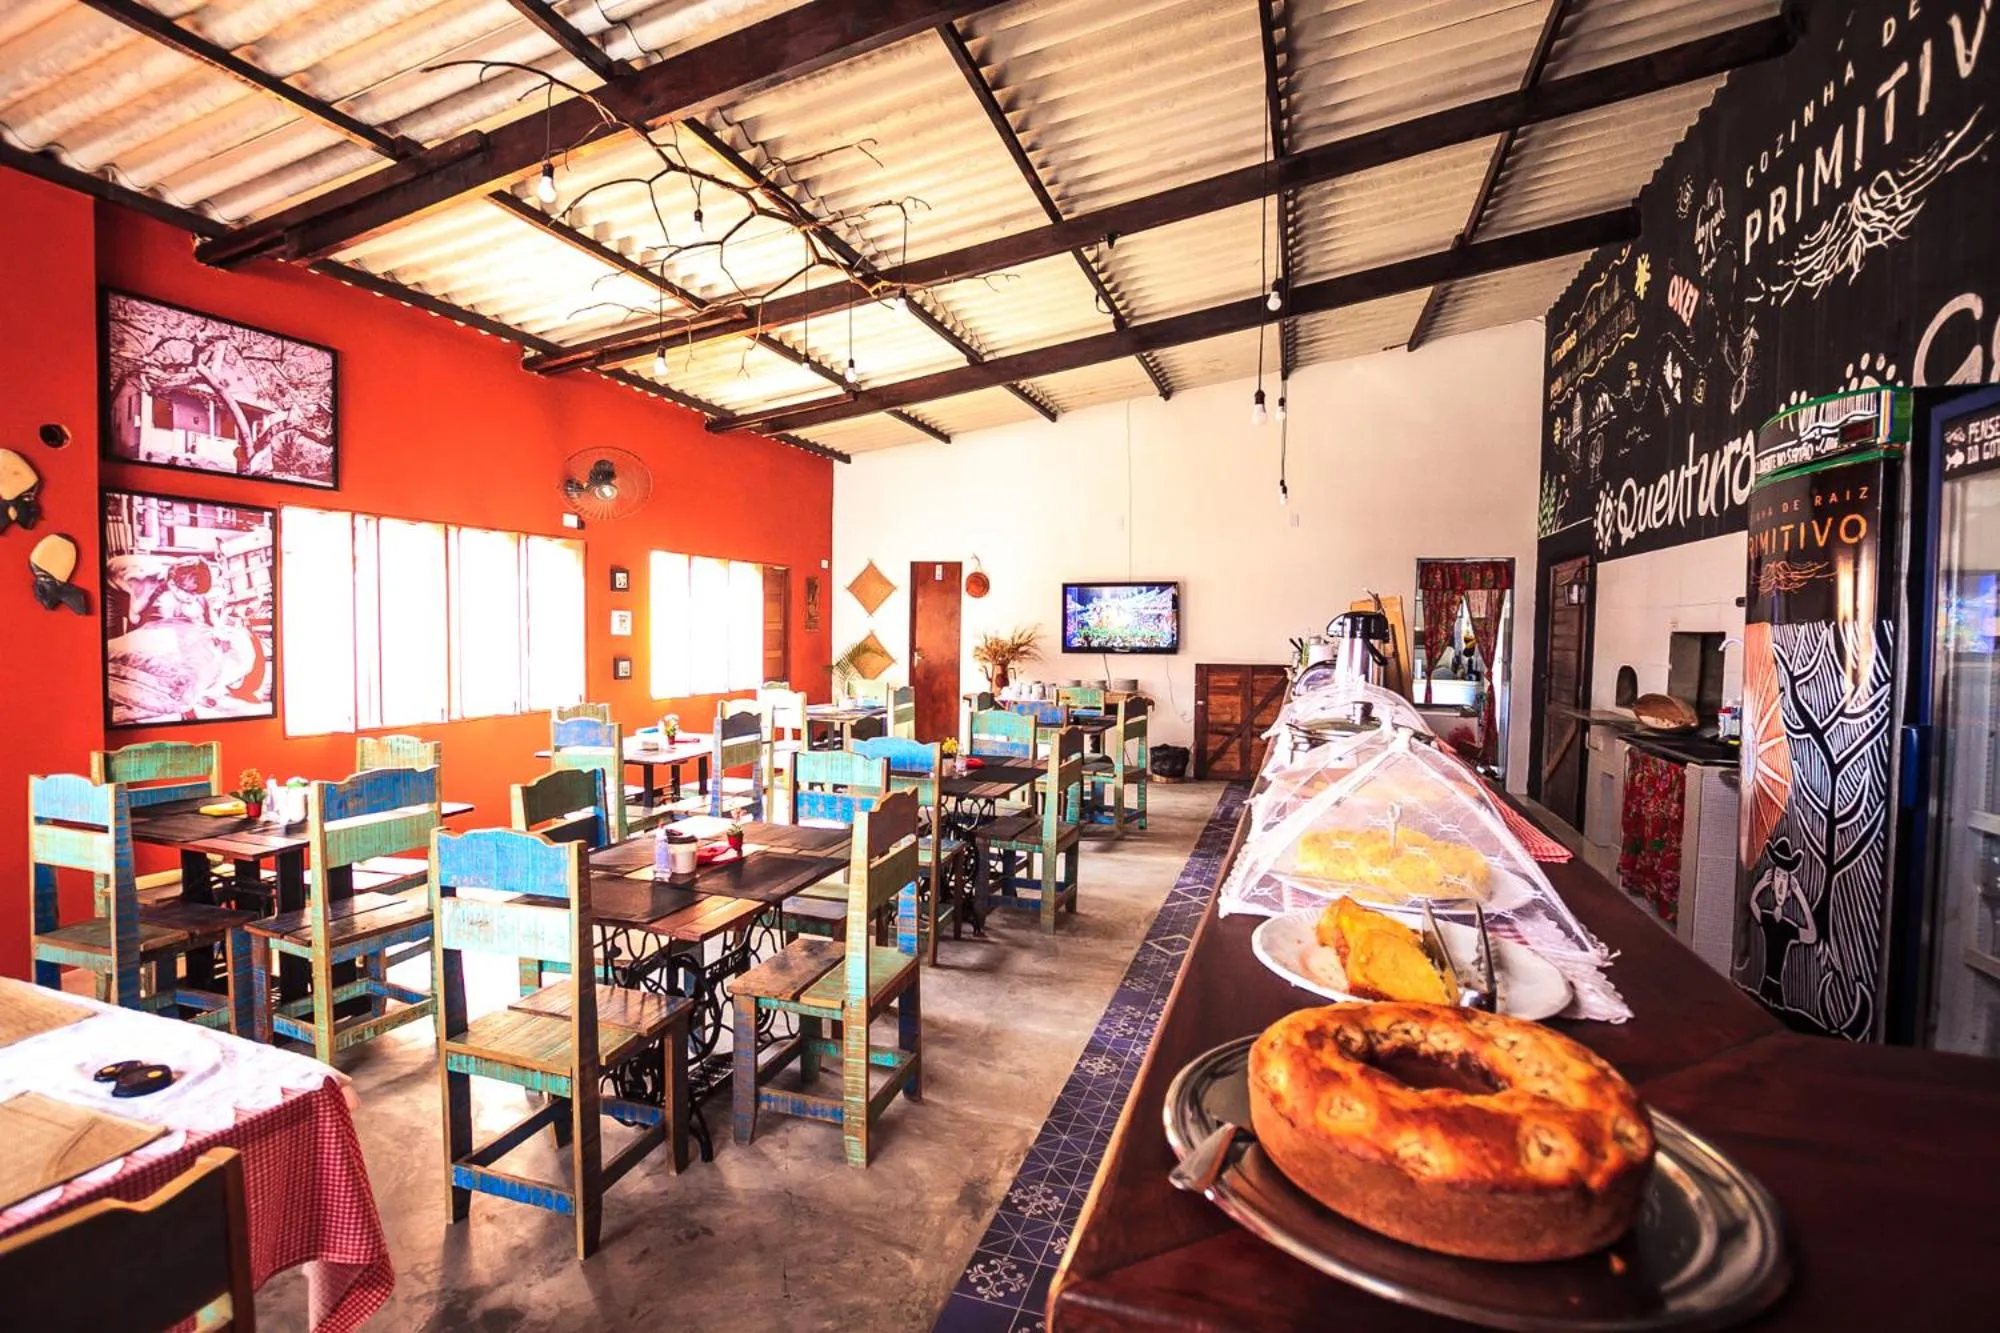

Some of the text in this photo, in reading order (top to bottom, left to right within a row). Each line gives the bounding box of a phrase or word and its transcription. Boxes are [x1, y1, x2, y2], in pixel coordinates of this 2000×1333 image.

[1746, 60, 1855, 188] COZINHA
[1782, 499, 1800, 513] DE
[1814, 486, 1869, 507] RAIZ
